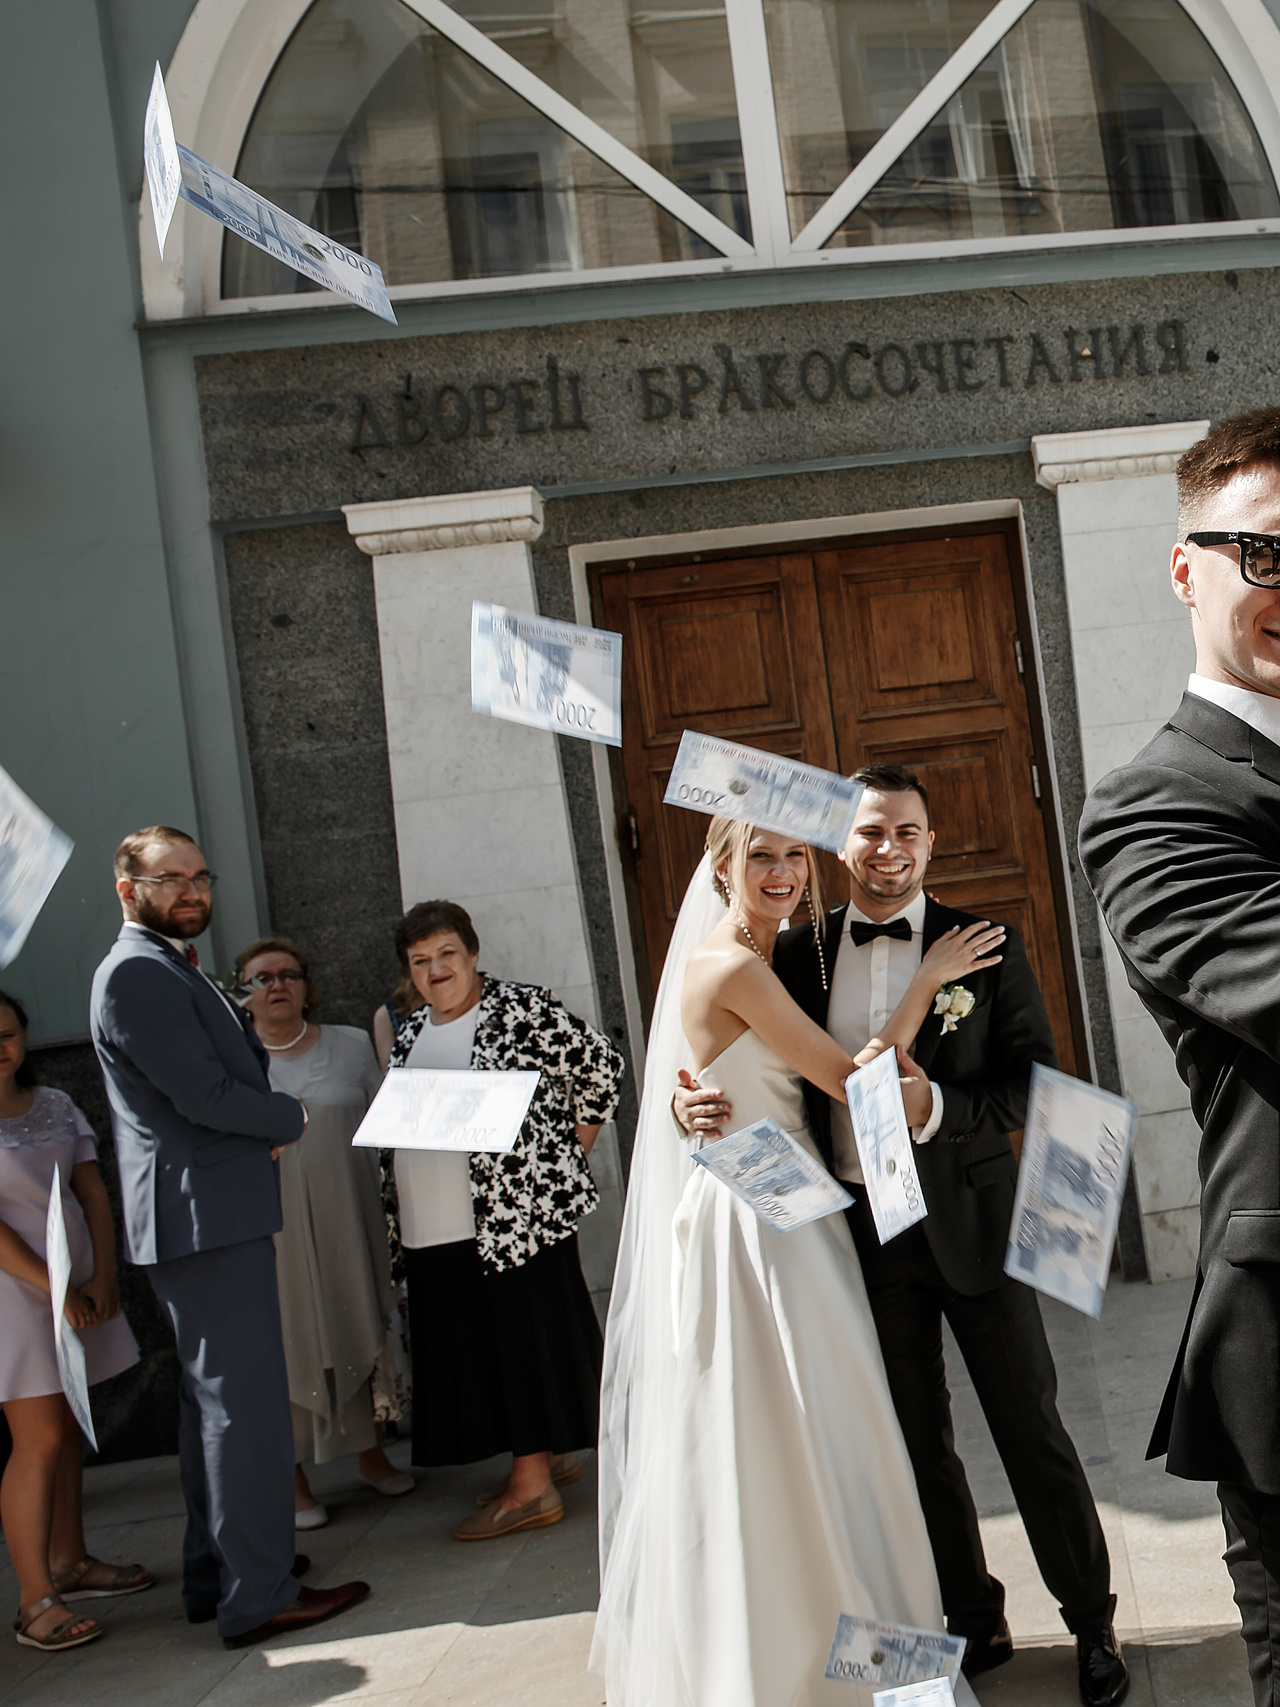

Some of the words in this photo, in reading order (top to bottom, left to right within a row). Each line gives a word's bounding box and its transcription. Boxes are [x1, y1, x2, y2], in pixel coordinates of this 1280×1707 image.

[319, 237, 372, 277] 2000
[350, 357, 591, 455] ДВОРЕЦ
[637, 319, 1191, 423] БРАКОСОЧЕТАНИЯ
[556, 698, 597, 731] 2000
[678, 783, 727, 810] 2000
[900, 1165, 920, 1213] 2000
